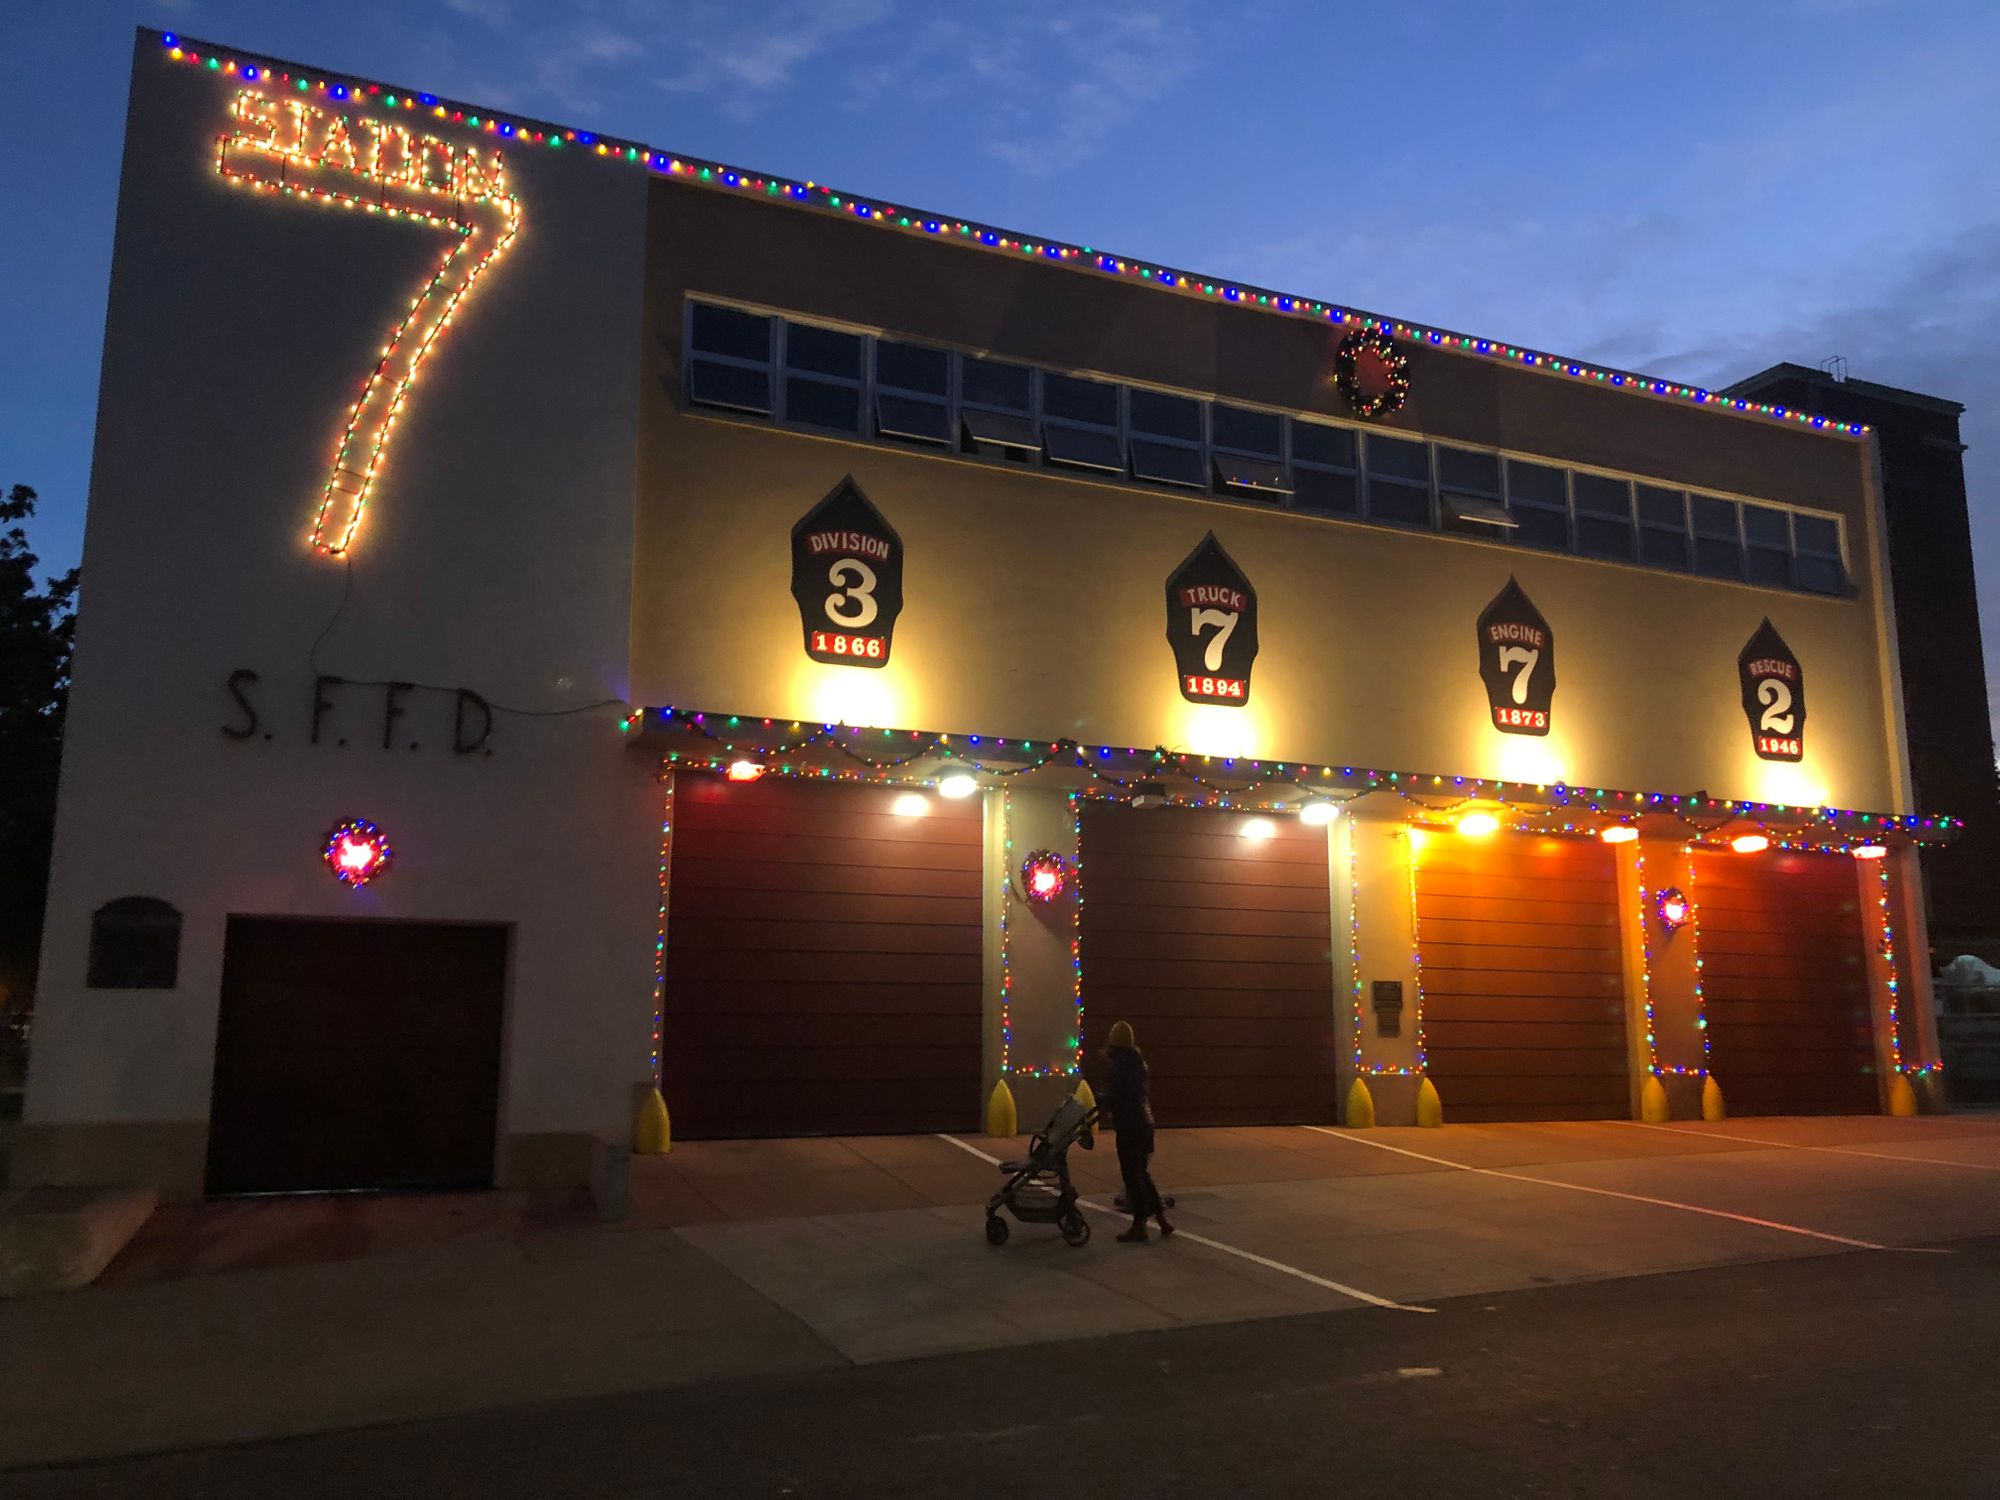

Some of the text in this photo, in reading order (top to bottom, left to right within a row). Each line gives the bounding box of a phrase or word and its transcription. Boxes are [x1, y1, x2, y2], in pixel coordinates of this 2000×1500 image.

[810, 532, 889, 559] DIVISION
[824, 558, 879, 629] 3
[1187, 586, 1241, 608] TRUCK
[816, 634, 880, 659] 1866
[1191, 607, 1239, 672] 7
[1490, 624, 1543, 646] ENGINE
[1498, 645, 1539, 705] 7
[1749, 659, 1793, 678] RESCUE
[1188, 677, 1241, 697] 1894
[1757, 678, 1794, 734] 2
[1499, 709, 1546, 728] 1873
[1760, 738, 1799, 755] 1946
